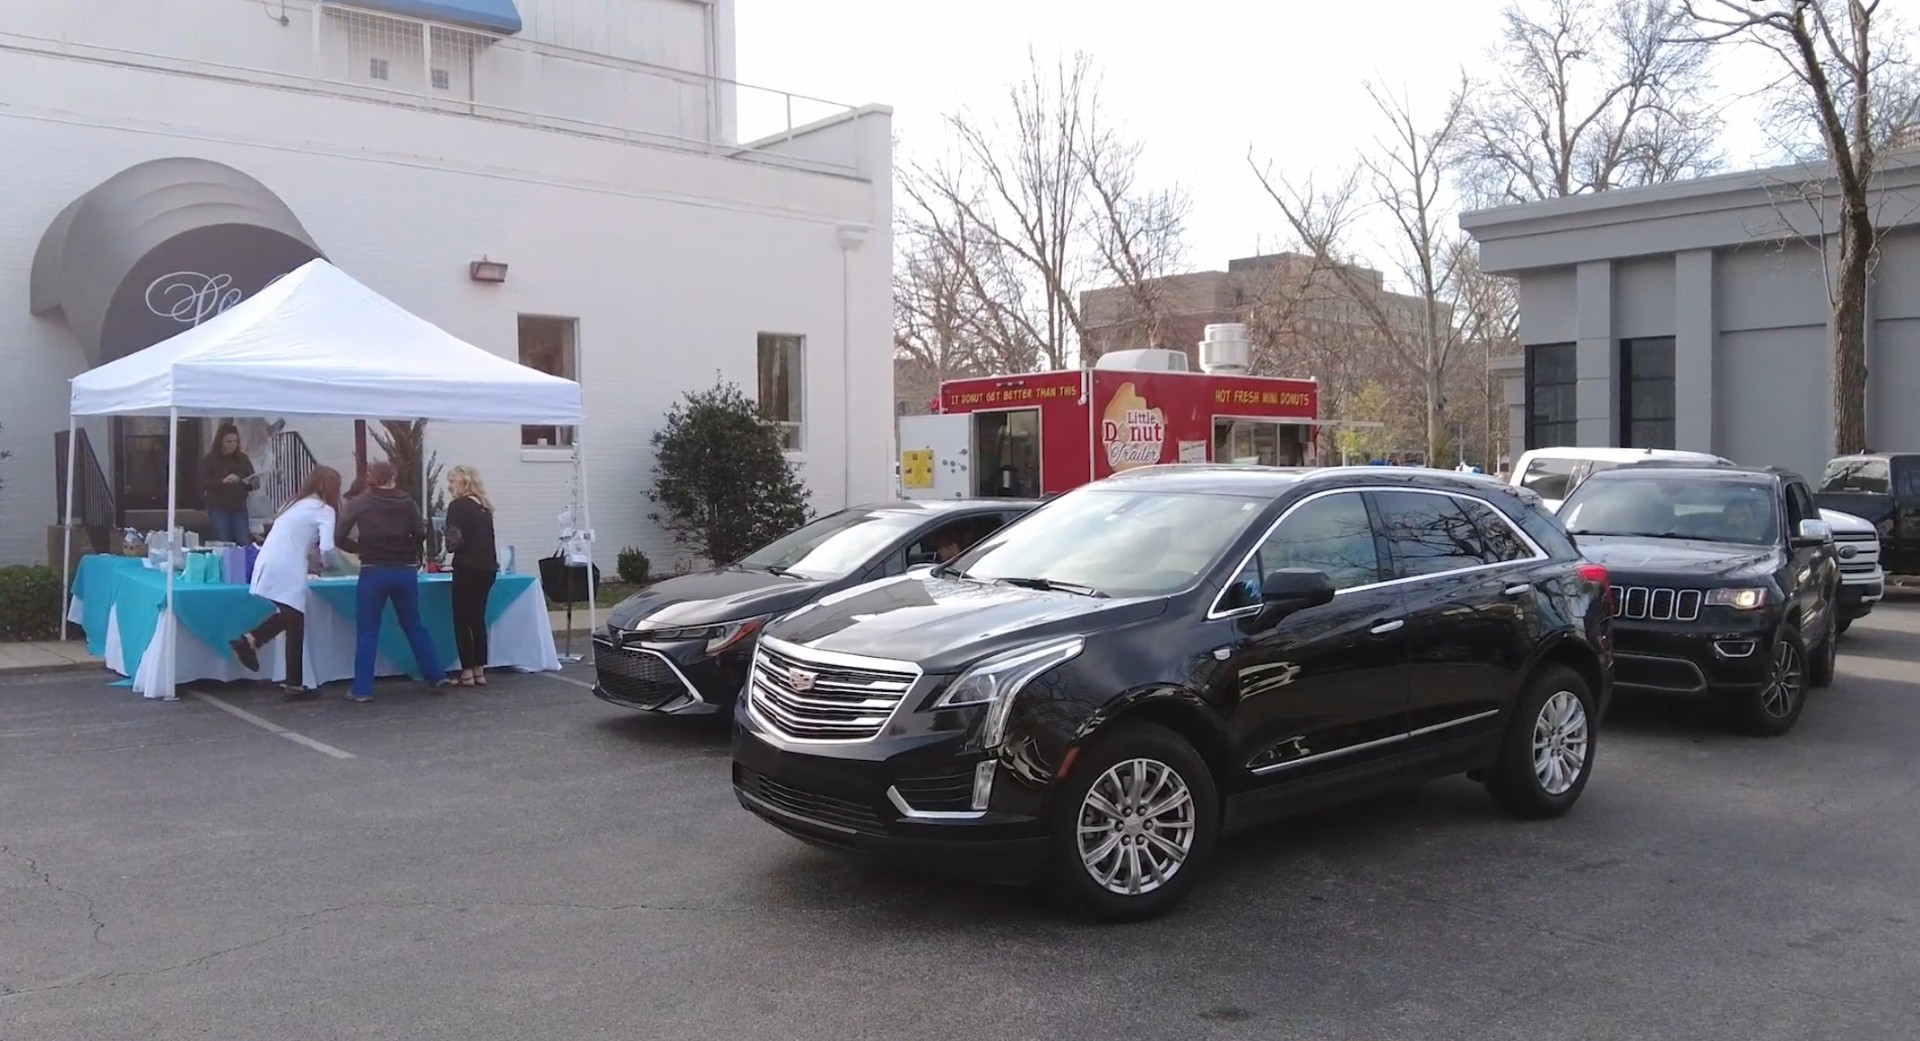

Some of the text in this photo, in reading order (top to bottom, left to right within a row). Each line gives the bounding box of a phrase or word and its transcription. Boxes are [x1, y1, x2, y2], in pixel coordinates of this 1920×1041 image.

[951, 385, 1077, 405] IT DONUT GET BETTER THAN THIS
[1215, 389, 1310, 406] HOT FRESH MINI DONUTS
[1127, 411, 1156, 424] Little
[1110, 440, 1159, 464] Trailer
